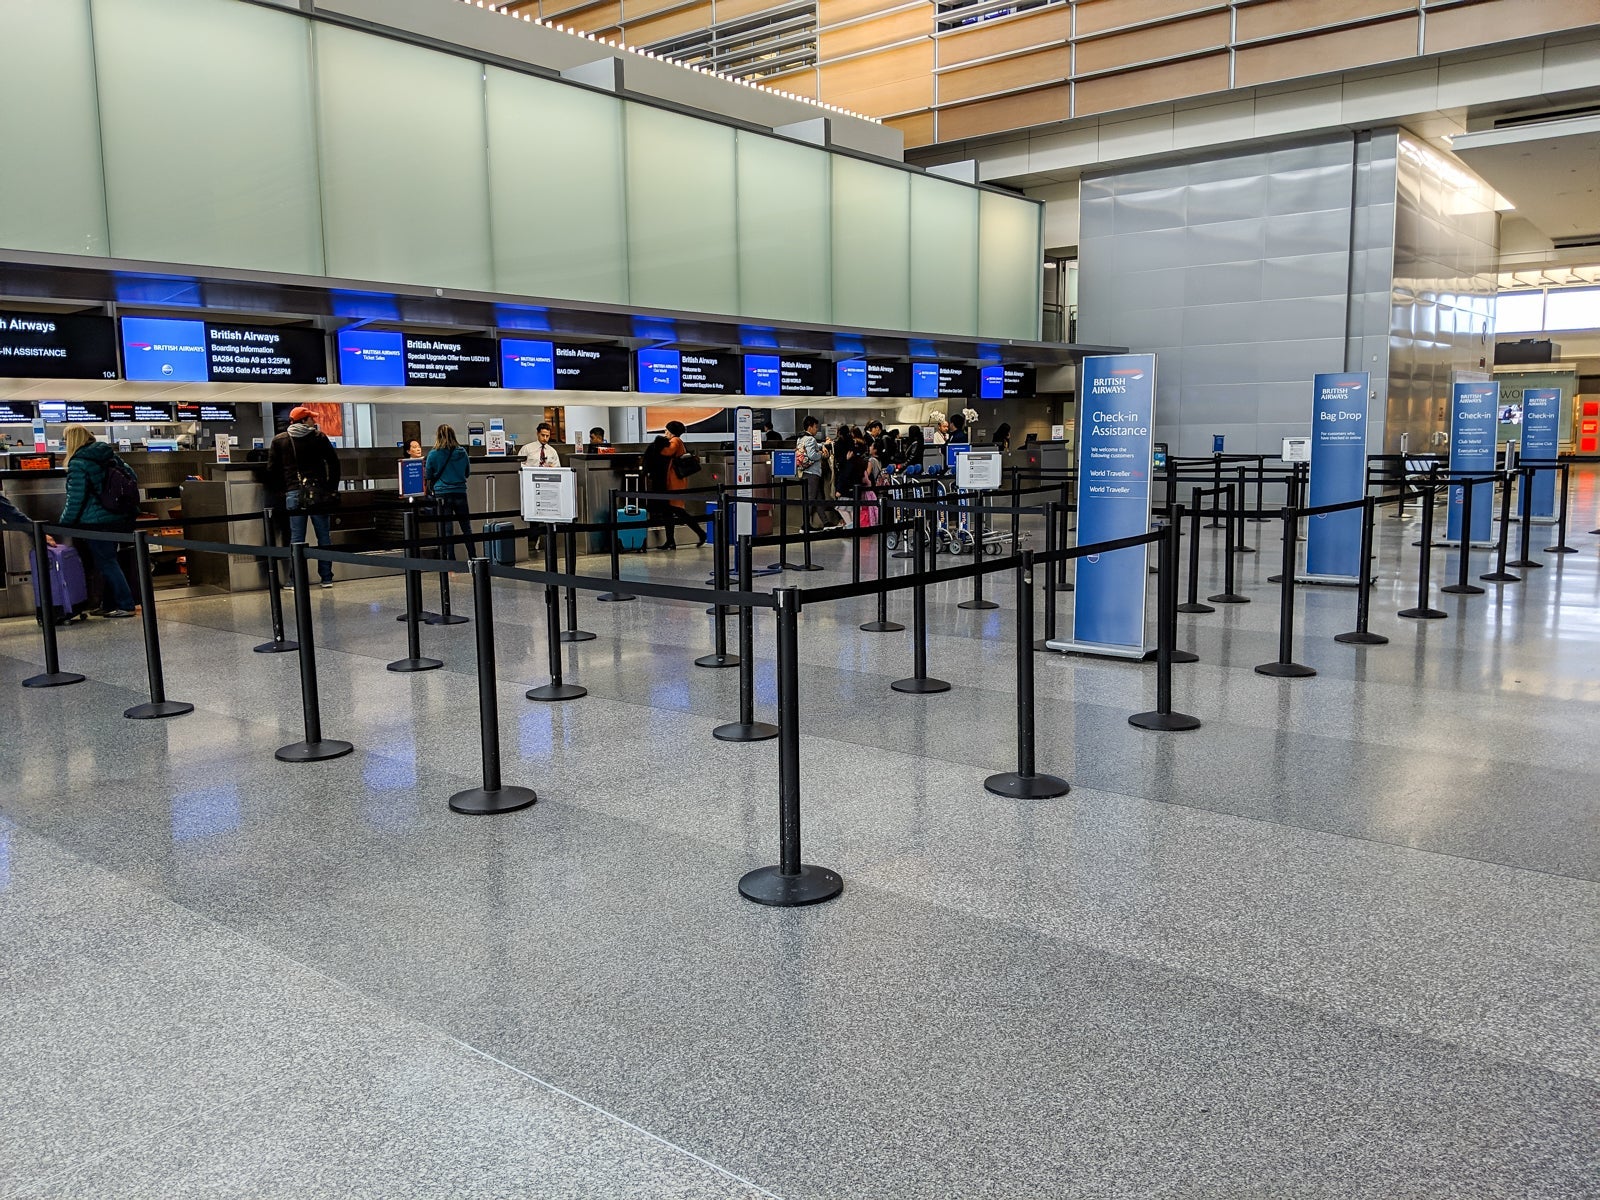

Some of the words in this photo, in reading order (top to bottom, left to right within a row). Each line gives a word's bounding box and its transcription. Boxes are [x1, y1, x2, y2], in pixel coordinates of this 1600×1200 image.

[9, 318, 56, 333] Airways
[210, 329, 242, 340] British
[243, 331, 280, 344] Airways
[211, 344, 240, 354] Boarding
[240, 345, 274, 354] Information
[406, 340, 432, 350] British
[433, 340, 462, 352] Airways
[13, 348, 67, 357] ASSISTANCE
[426, 353, 446, 362] Upgrade
[556, 348, 576, 357] British
[576, 350, 600, 360] Airways
[699, 356, 718, 366] Airways
[235, 366, 251, 374] Gate
[1093, 378, 1126, 386] BRITISH
[1092, 386, 1126, 394] AIRWAYS
[1092, 411, 1138, 423] Check-in
[1320, 411, 1336, 421] Bag
[1338, 411, 1362, 421] Drop
[1092, 425, 1147, 436] Assistance
